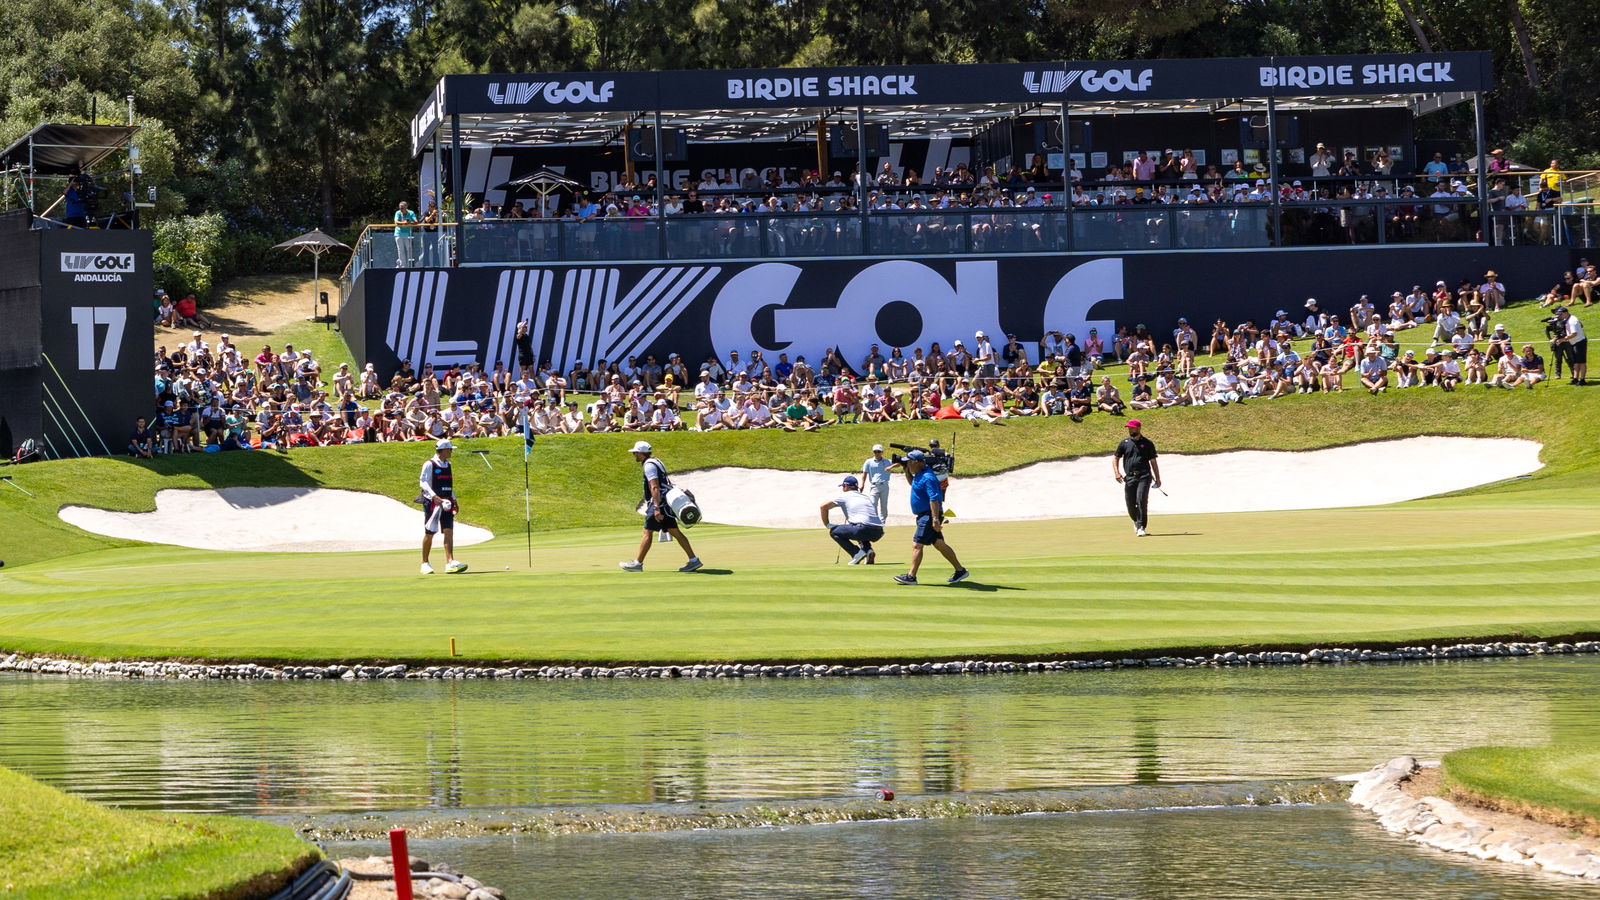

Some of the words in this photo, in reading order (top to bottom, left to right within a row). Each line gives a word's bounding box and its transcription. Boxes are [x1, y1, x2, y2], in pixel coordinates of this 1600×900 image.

[728, 79, 819, 101] BIRDIE
[828, 75, 918, 97] SHACK
[1260, 66, 1354, 88] BIRDIE
[1363, 62, 1454, 84] SHACK
[74, 272, 122, 282] ANDALUCÍA
[71, 306, 127, 370] 17
